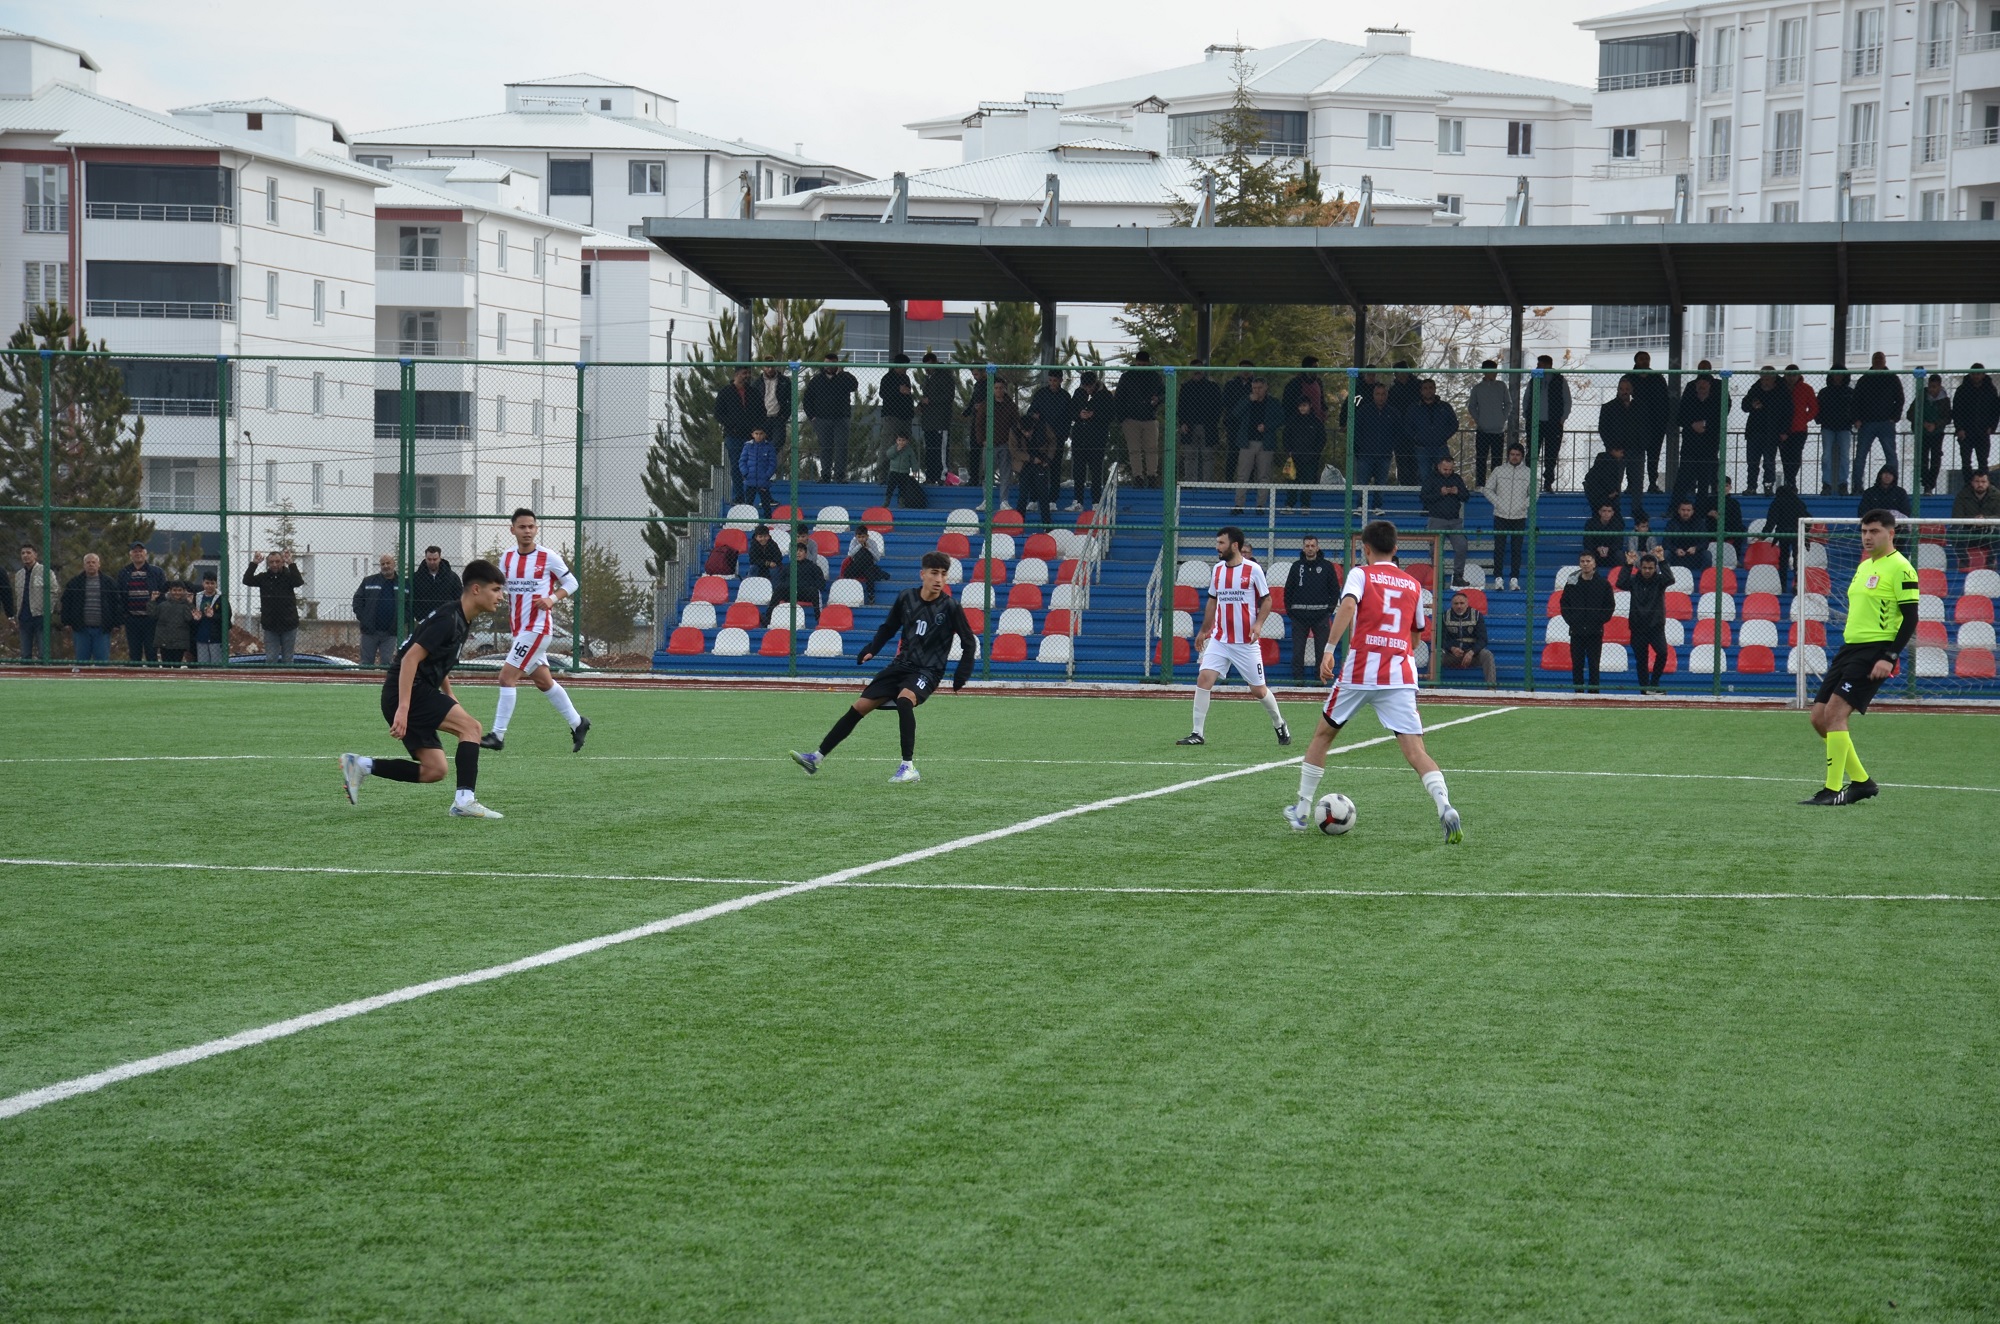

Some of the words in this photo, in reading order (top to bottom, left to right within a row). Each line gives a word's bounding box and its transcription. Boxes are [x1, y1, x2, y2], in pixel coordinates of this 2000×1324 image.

[1369, 572, 1416, 592] ELBİSTANSPOR
[1379, 588, 1403, 633] 5
[915, 619, 927, 636] 10
[1366, 634, 1387, 647] KEREM
[514, 642, 529, 658] 46
[1257, 663, 1263, 675] 8
[916, 678, 926, 690] 10
